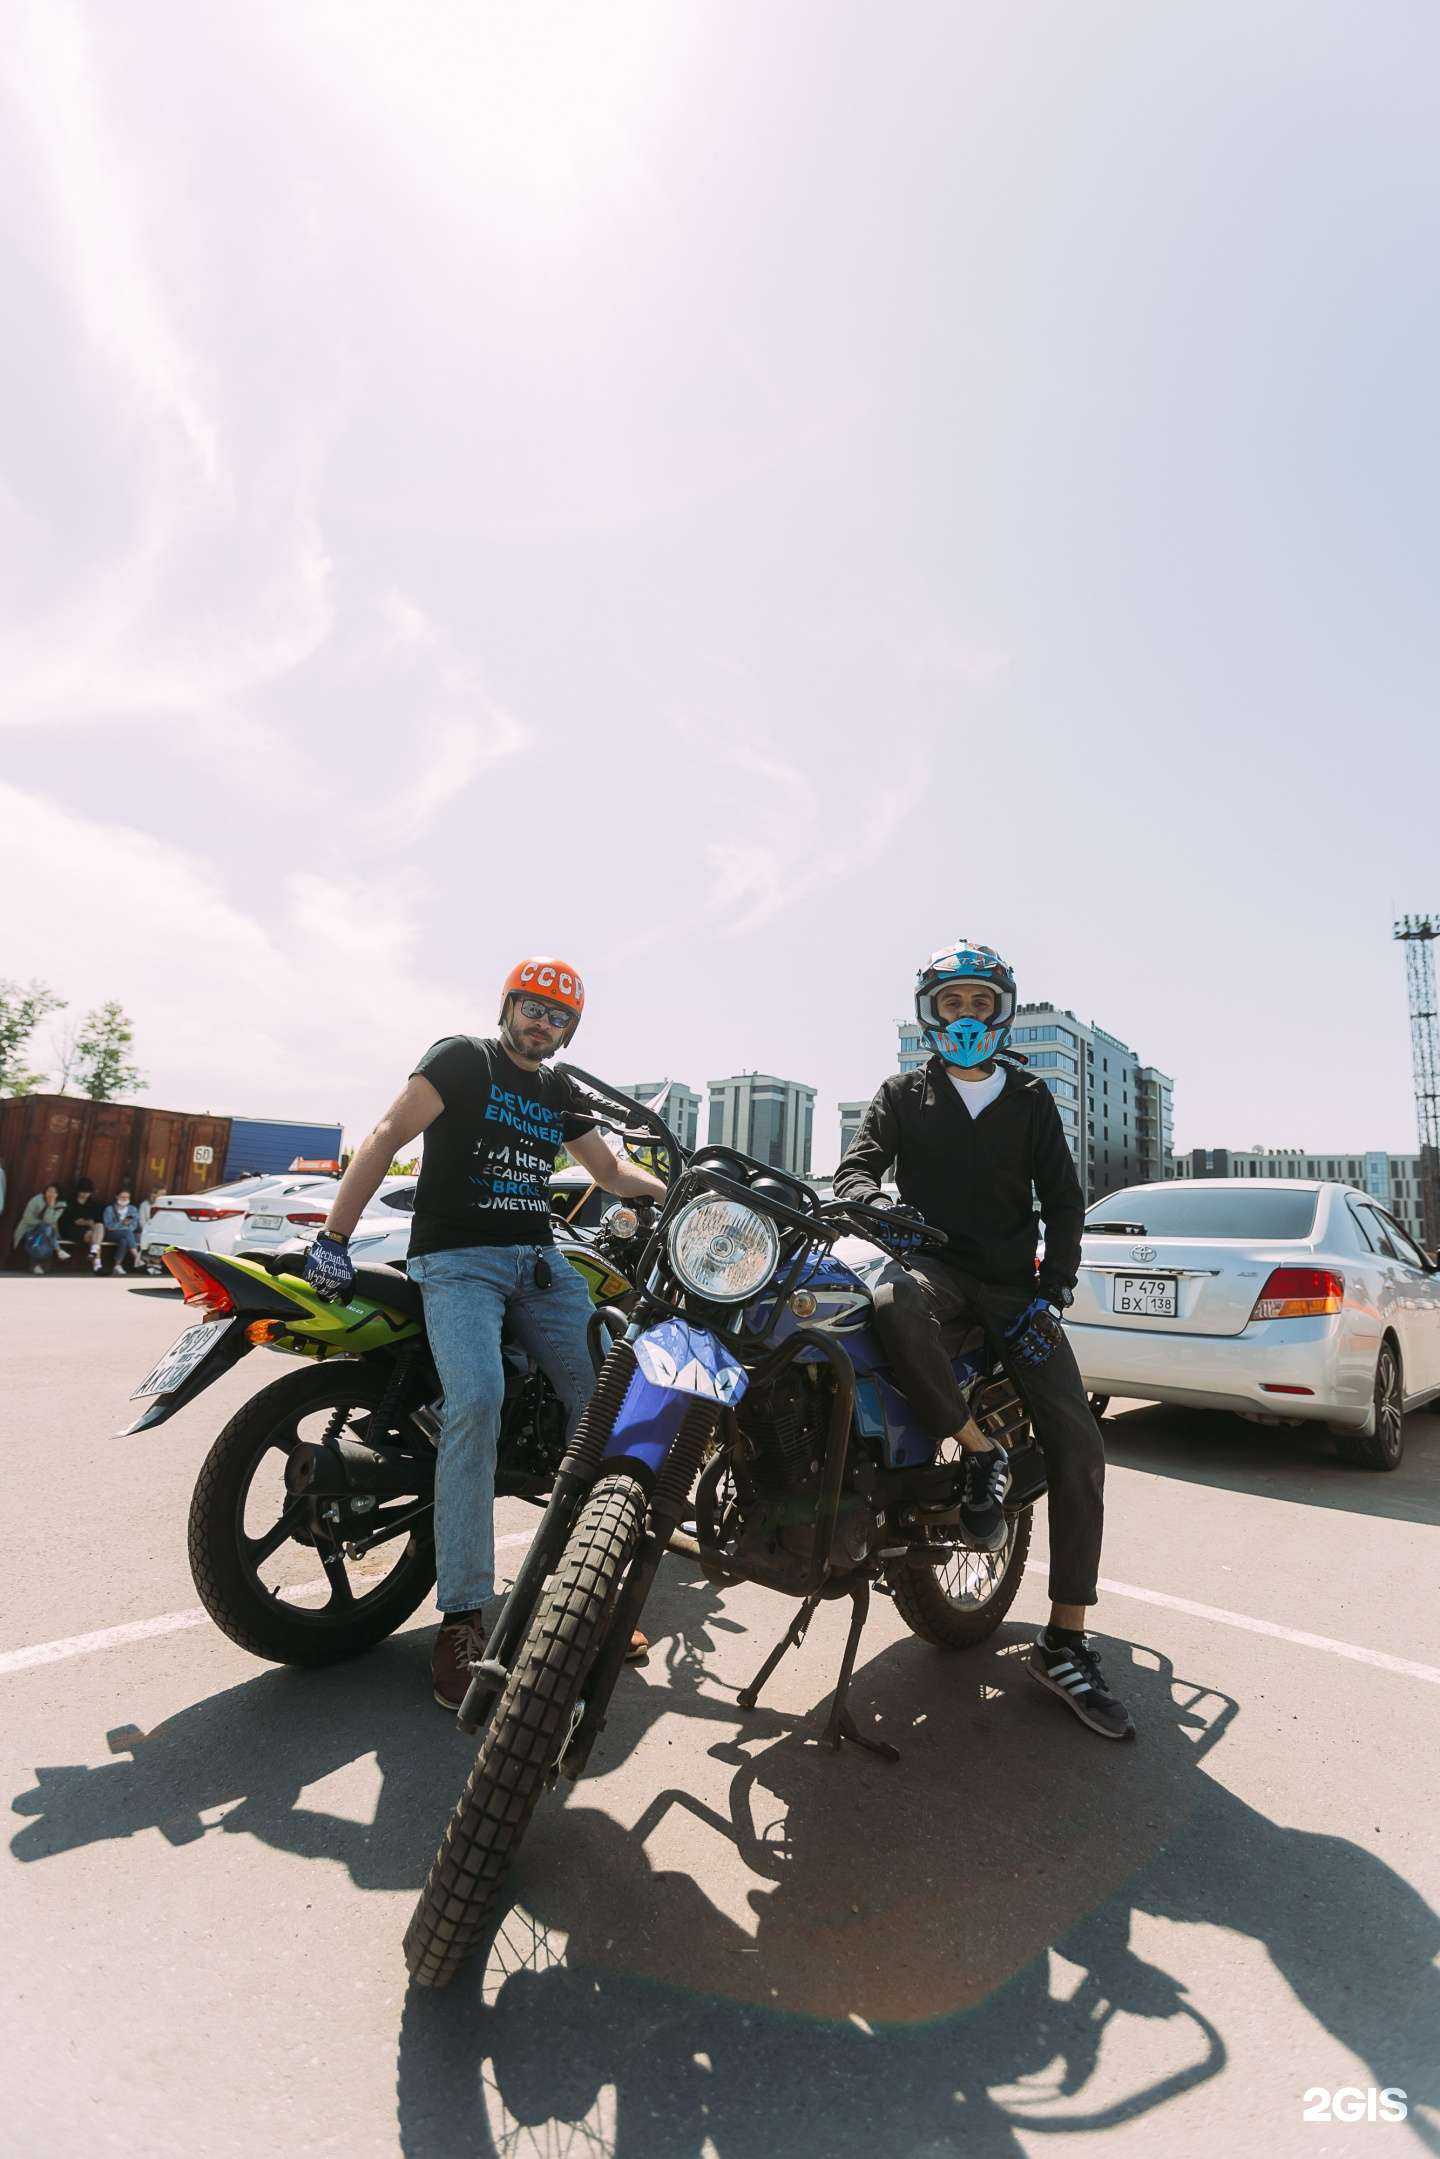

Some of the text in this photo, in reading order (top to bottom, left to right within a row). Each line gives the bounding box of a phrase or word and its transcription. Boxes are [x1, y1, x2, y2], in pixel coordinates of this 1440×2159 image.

[482, 1163, 539, 1183] ECAUSE
[316, 1260, 353, 1280] Mechanix
[1139, 1281, 1166, 1295] 479
[1150, 1299, 1172, 1310] 138
